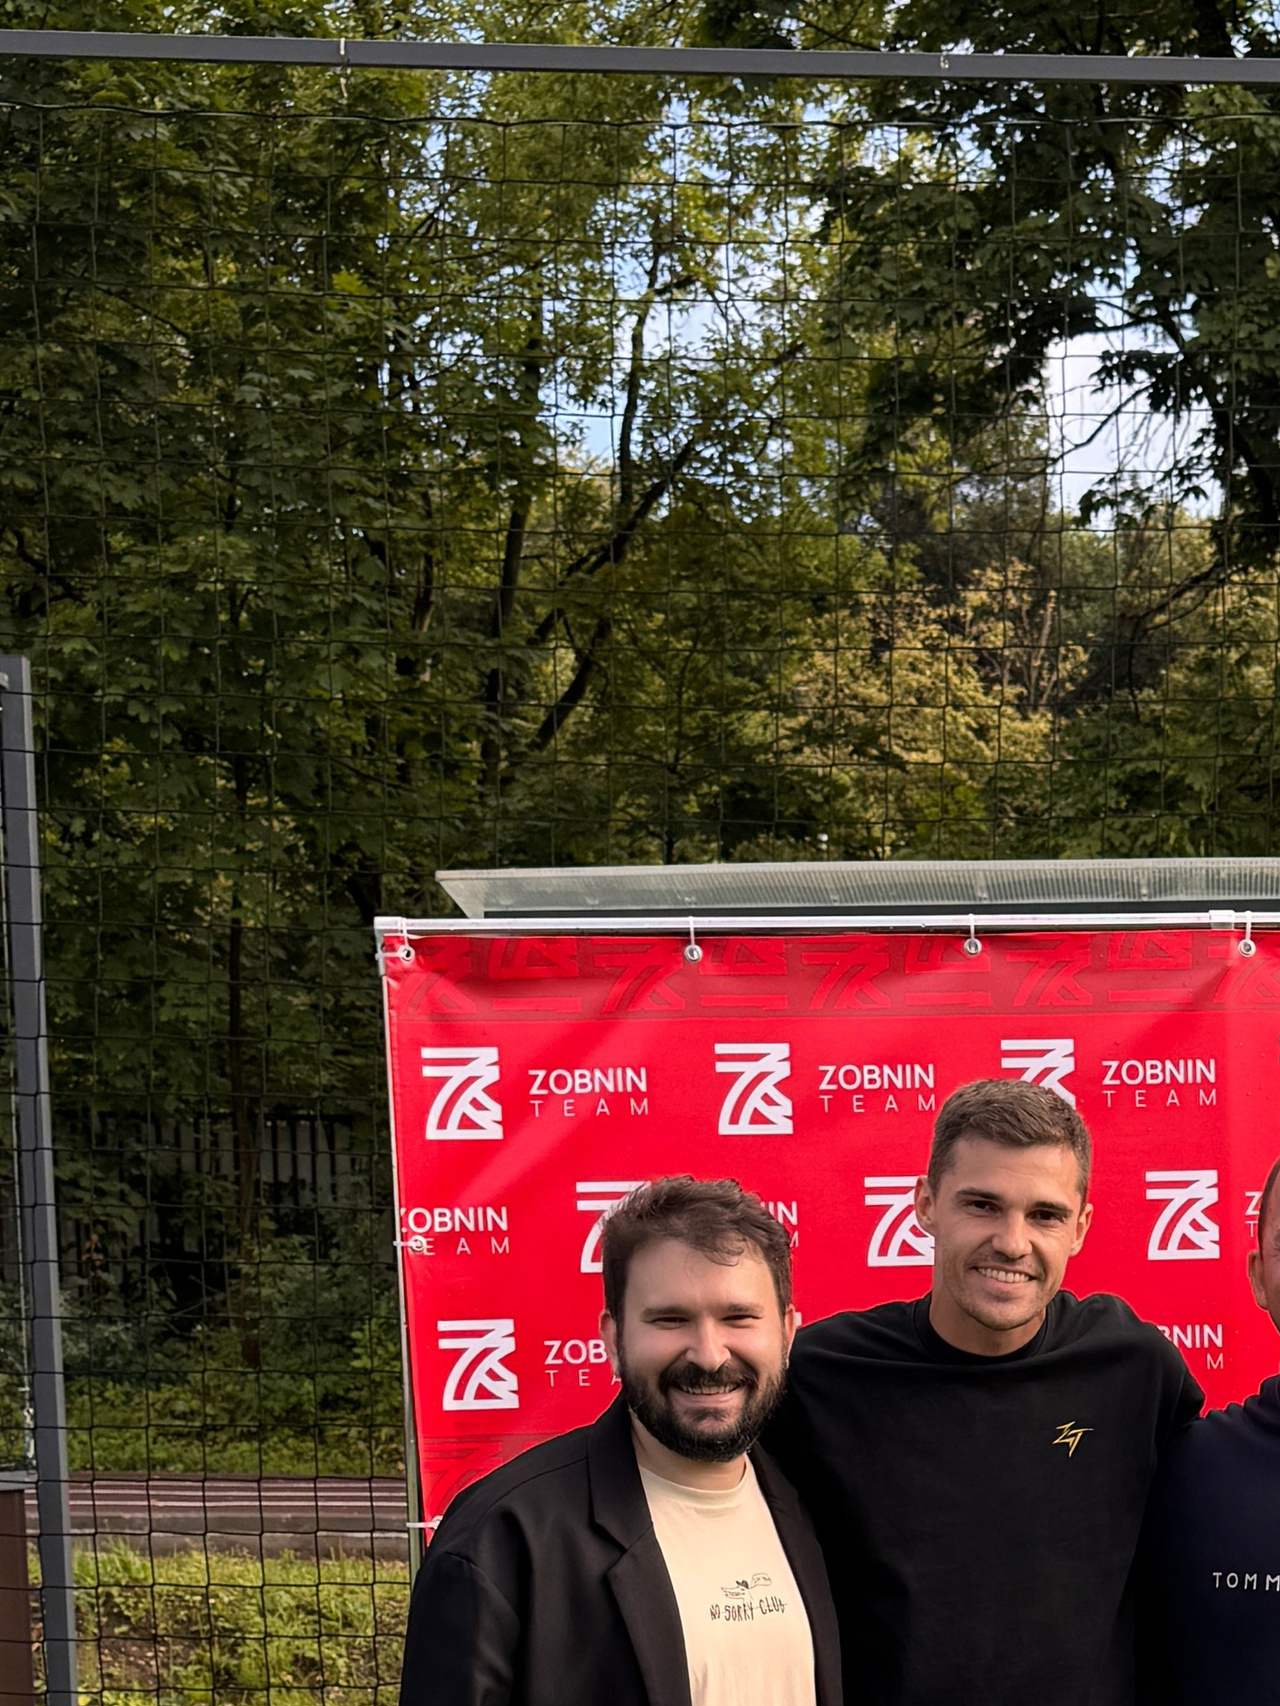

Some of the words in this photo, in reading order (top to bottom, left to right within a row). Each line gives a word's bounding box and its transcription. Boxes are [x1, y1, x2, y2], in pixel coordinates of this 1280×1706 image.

[529, 1067, 647, 1095] ZOBNIN
[819, 1063, 935, 1090] ZOBNIN
[1102, 1058, 1216, 1085] ZOBNIN
[530, 1098, 649, 1117] TEAM
[820, 1094, 936, 1112] TEAM
[1102, 1088, 1217, 1107] TEAM
[423, 1236, 510, 1256] EAM
